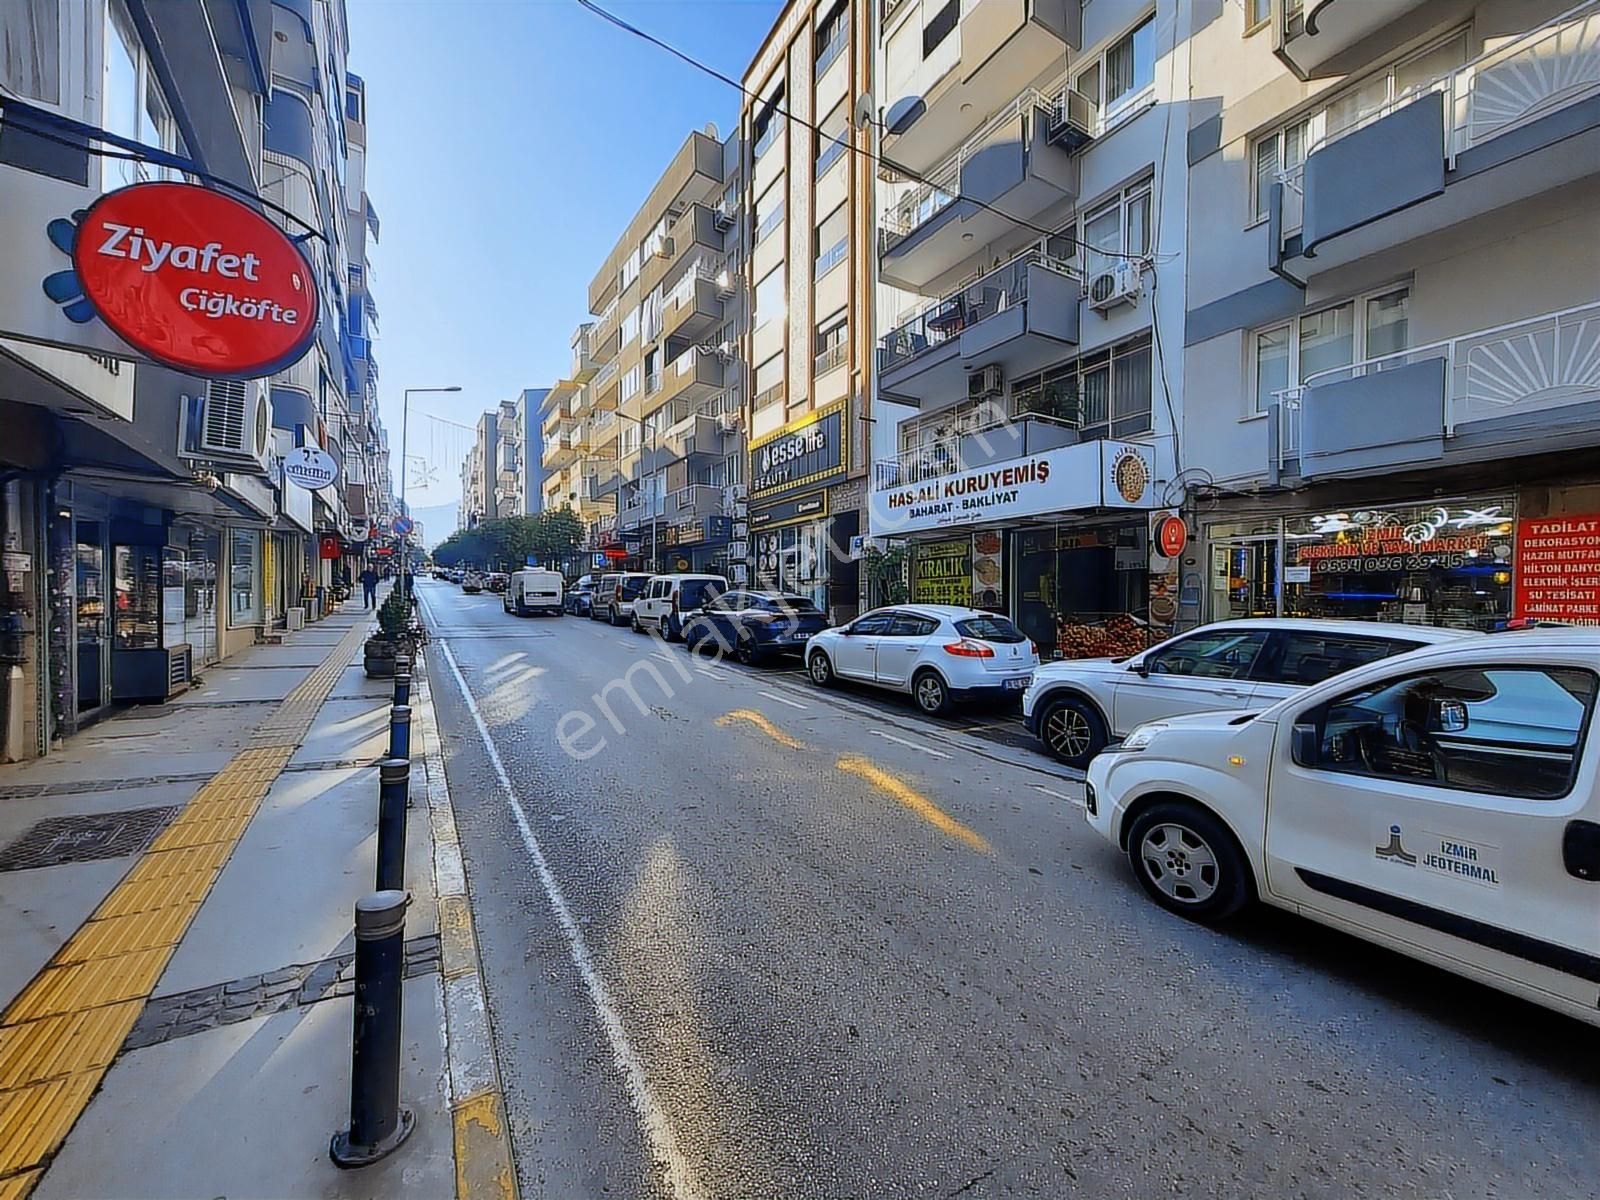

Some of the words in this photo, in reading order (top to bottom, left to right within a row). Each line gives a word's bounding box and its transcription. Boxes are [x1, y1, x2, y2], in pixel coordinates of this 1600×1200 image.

[98, 222, 260, 281] Ziyafet
[179, 287, 298, 325] Çiğköfte
[754, 469, 791, 490] BEAUTY
[944, 459, 1050, 498] KURUYEMİŞ
[909, 503, 953, 519] BAHARAT
[962, 490, 1019, 510] BAKLİYAT
[1531, 520, 1598, 534] TADİLAT
[1420, 535, 1488, 552] MARKET
[1317, 558, 1361, 573] 0534
[1436, 553, 1464, 569] 45
[1523, 551, 1555, 561] HAZIR
[917, 556, 965, 578] KİRALIK
[1523, 562, 1561, 574] HİLTON
[1523, 575, 1568, 587] ELEKTRİK
[1571, 574, 1600, 587] İŞLER
[1528, 590, 1543, 600] SU
[1546, 588, 1596, 600] TESİSATI
[1524, 602, 1565, 613] LAMİNAT
[1566, 604, 1599, 614] PARKE
[1422, 854, 1499, 884] JEOTERMAL
